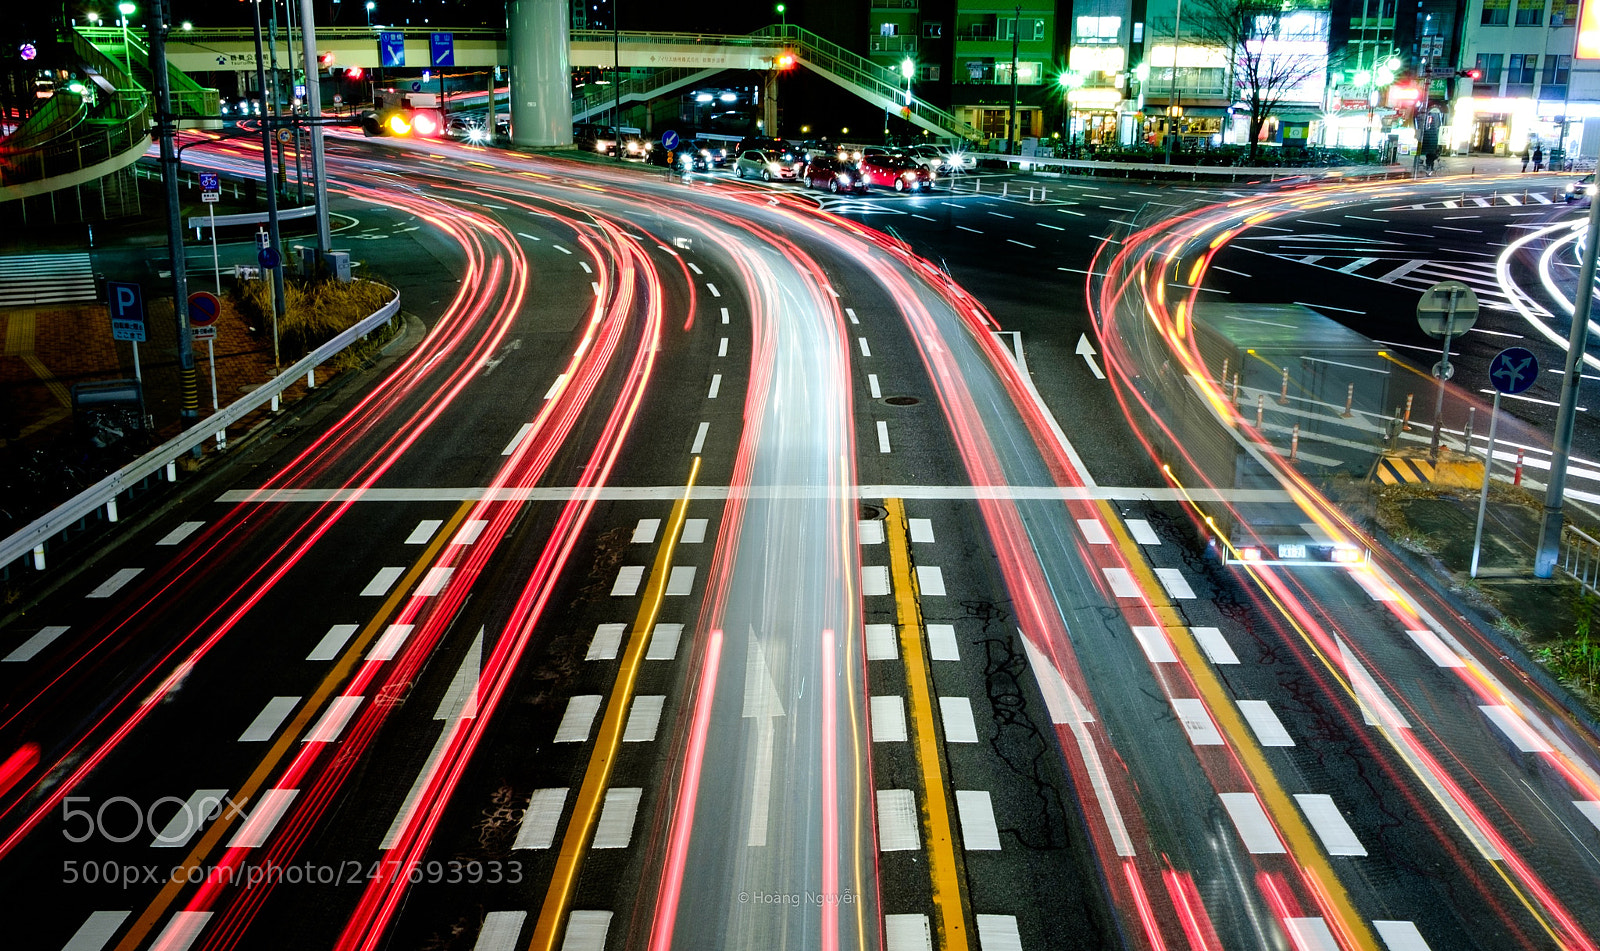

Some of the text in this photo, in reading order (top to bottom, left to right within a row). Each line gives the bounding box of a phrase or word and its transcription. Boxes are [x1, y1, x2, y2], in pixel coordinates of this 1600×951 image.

[117, 287, 135, 315] P
[117, 331, 142, 340] ここまで
